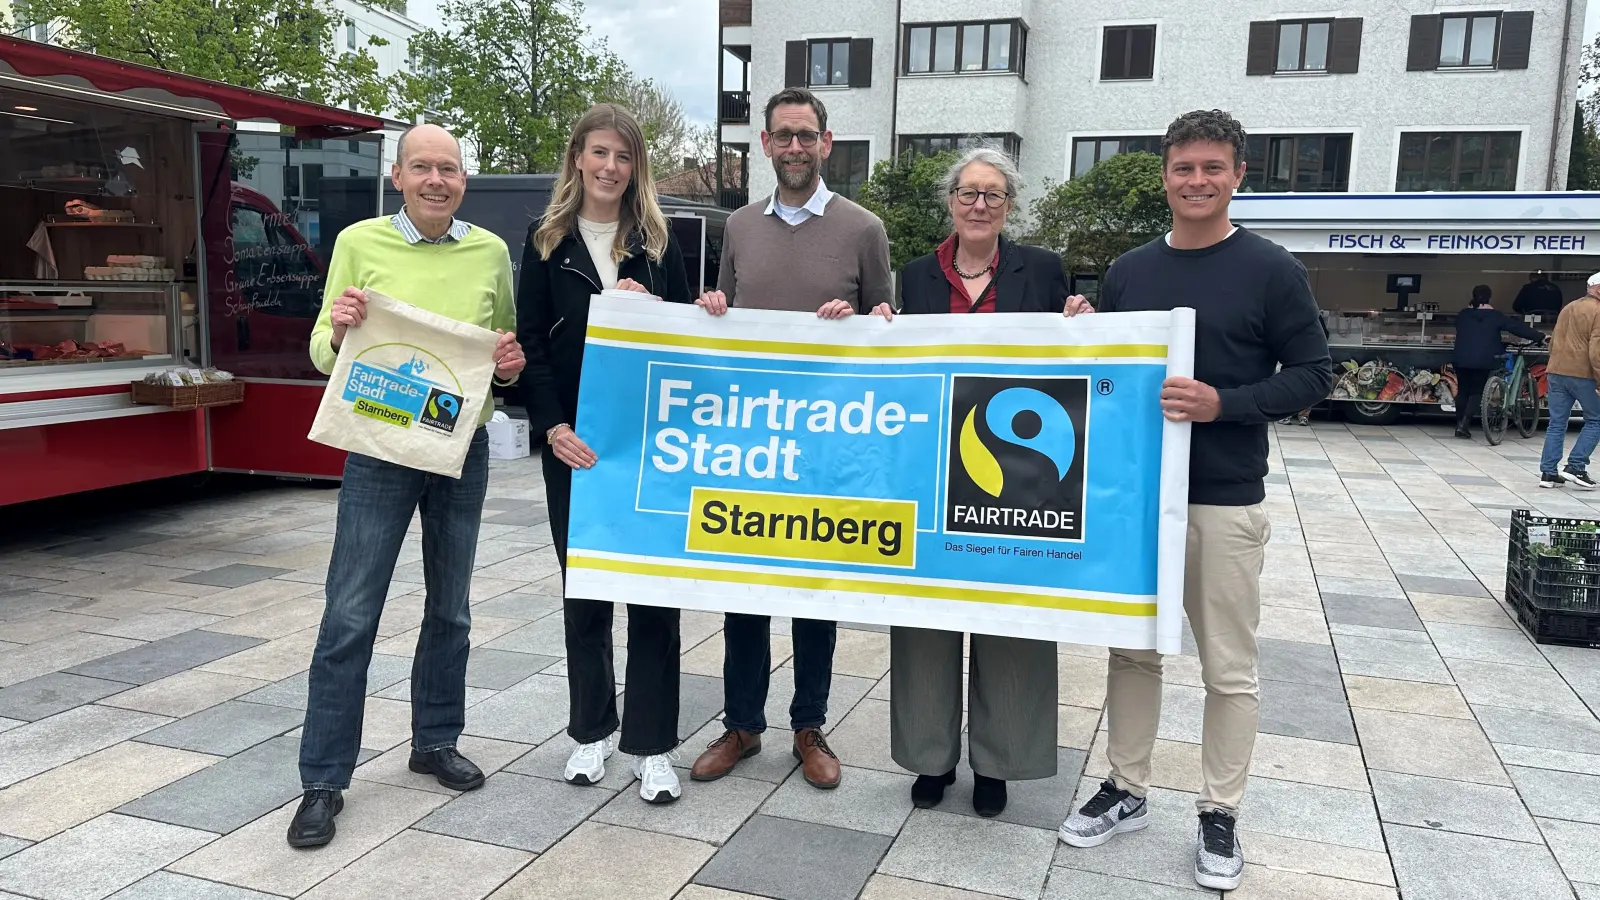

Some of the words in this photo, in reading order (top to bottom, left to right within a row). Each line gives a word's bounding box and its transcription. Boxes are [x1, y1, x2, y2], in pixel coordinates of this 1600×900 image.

[1328, 234, 1384, 249] FISCH
[1427, 235, 1526, 250] FEINKOST
[1533, 235, 1586, 250] REEH
[348, 379, 387, 400] Stadt
[352, 366, 424, 397] Fairtrade-
[357, 400, 409, 426] Starnberg
[657, 378, 929, 436] Fairtrade-
[421, 416, 453, 431] FAIRTRADE
[651, 427, 801, 481] Stadt
[700, 500, 903, 557] Starnberg
[953, 504, 1075, 530] FAIRTRADE
[944, 541, 964, 552] Das
[965, 543, 996, 556] Siegel
[997, 545, 1012, 556] für
[1013, 546, 1044, 558] Fairen
[1046, 548, 1083, 560] Handel
